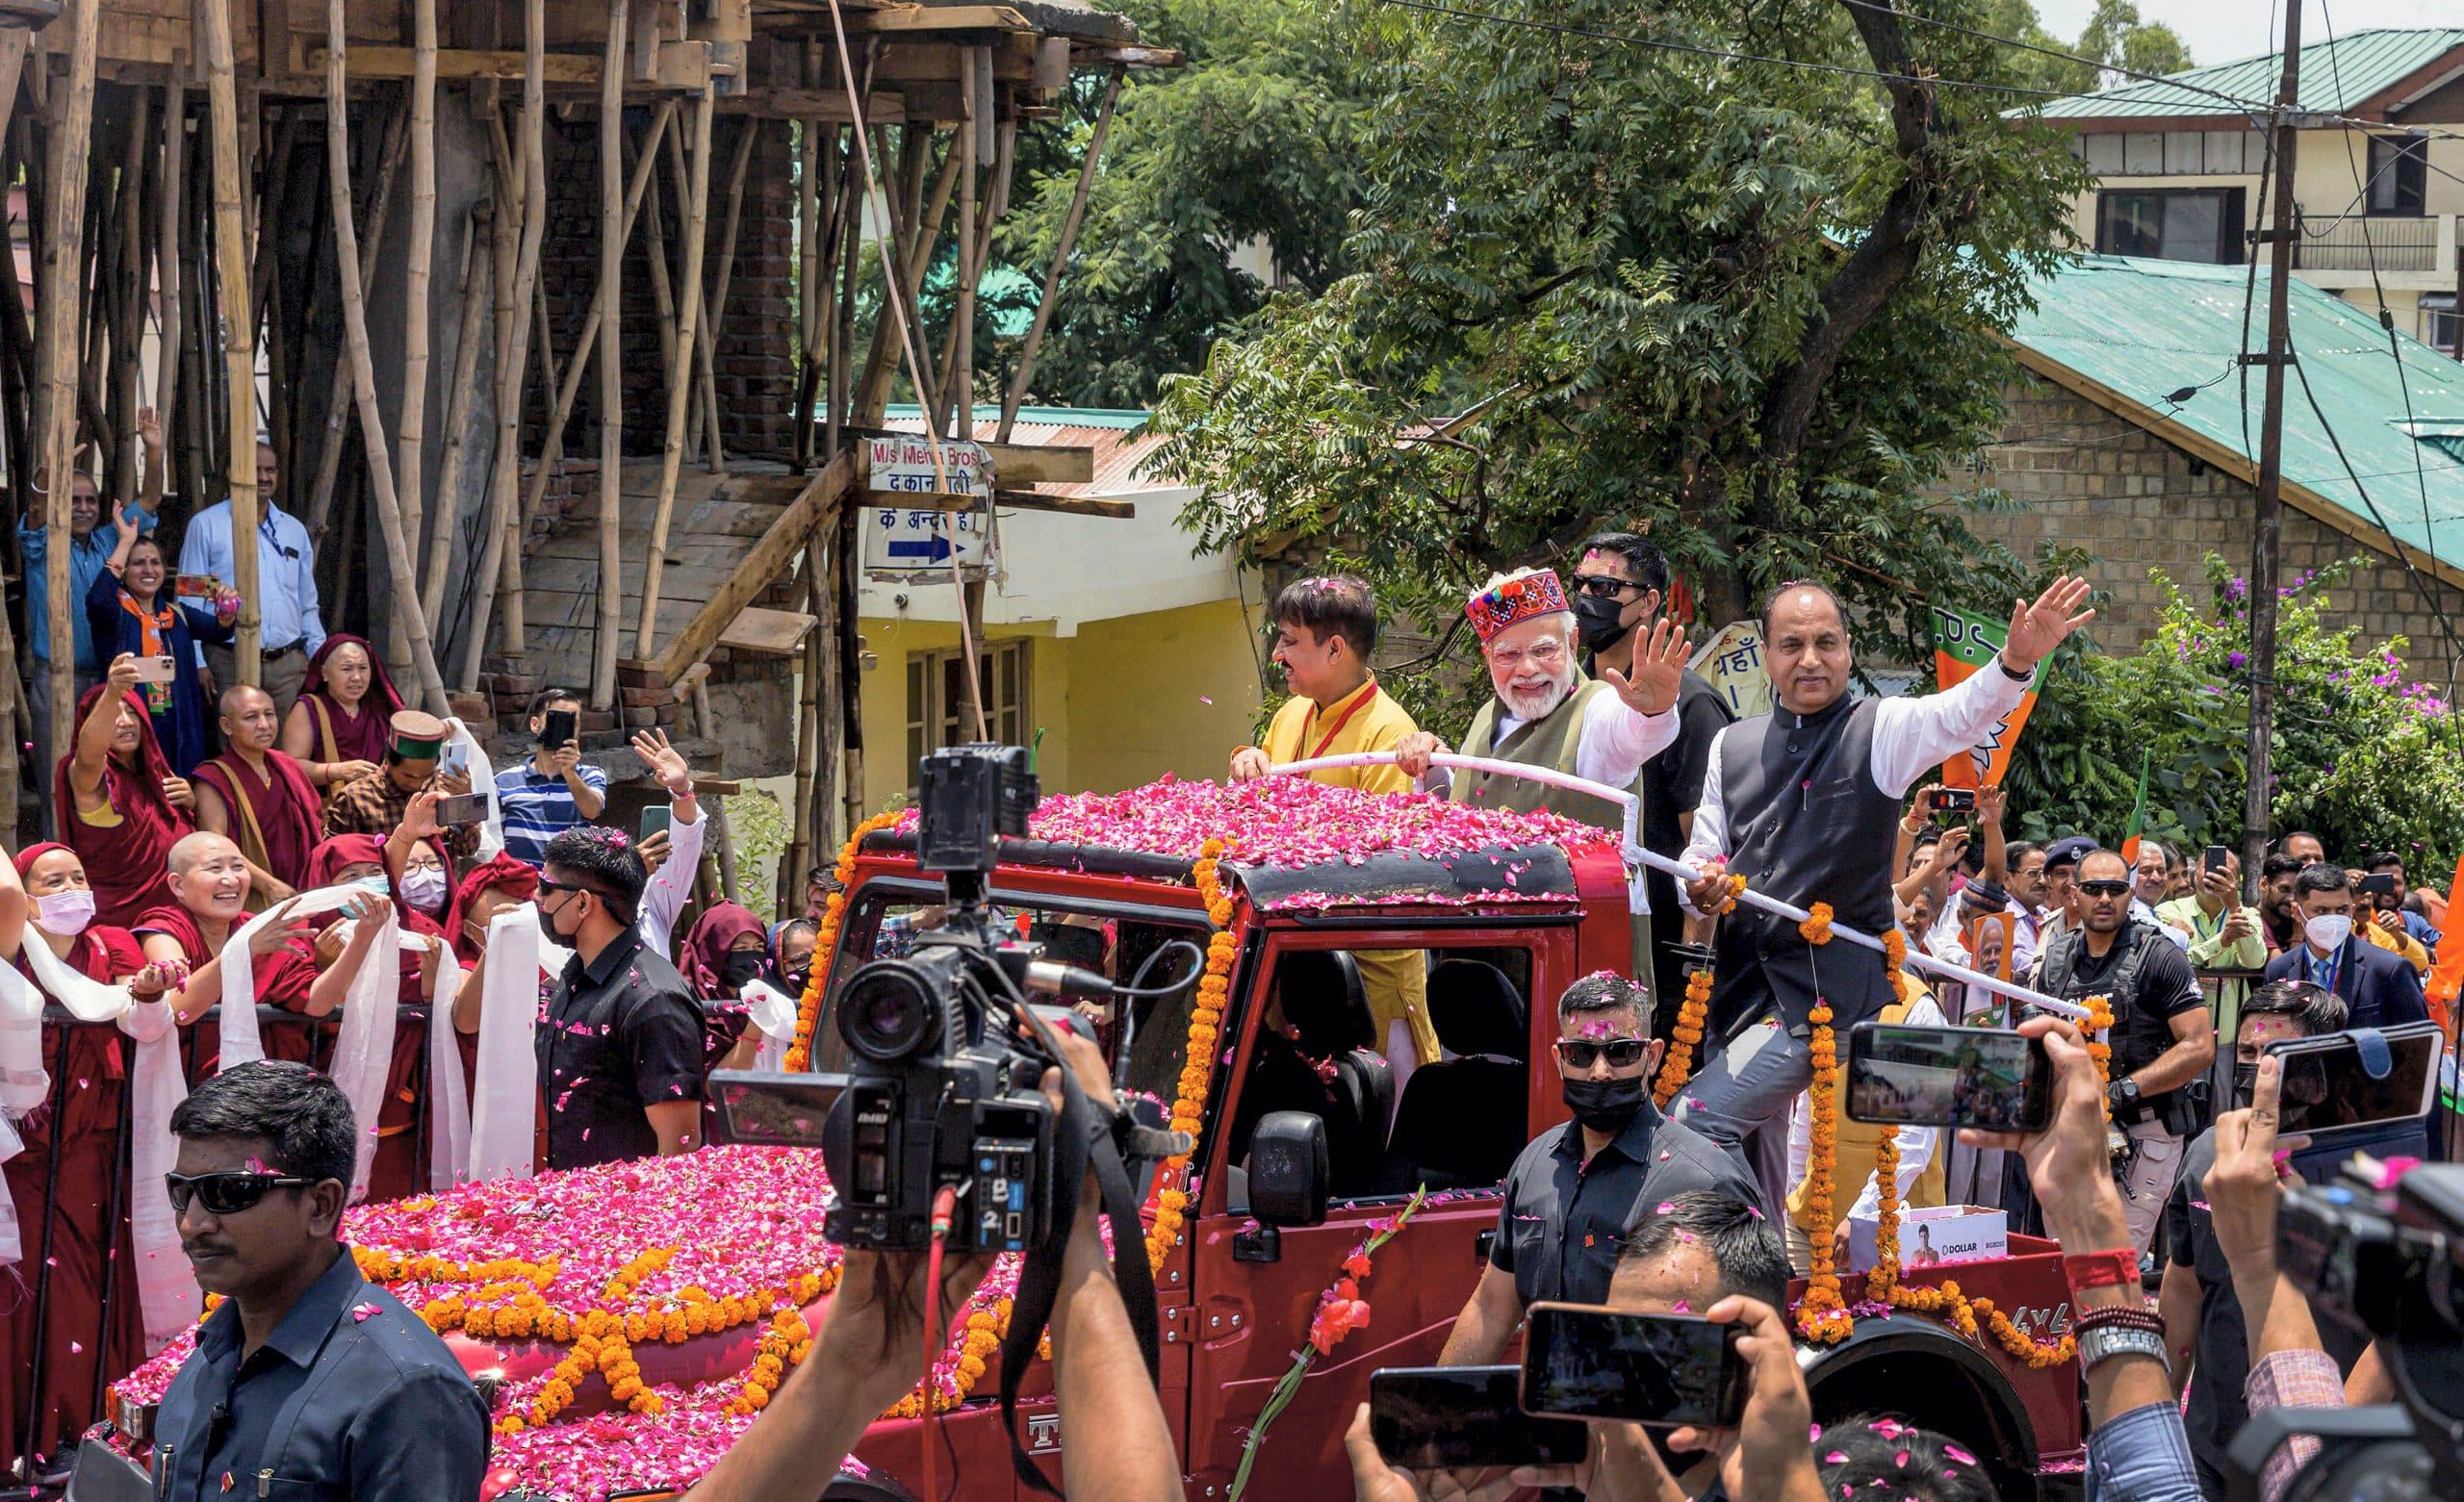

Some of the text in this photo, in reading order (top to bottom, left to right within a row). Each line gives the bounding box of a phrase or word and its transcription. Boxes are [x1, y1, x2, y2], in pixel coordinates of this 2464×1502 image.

[873, 444, 898, 463] M/s
[903, 446, 945, 466] Meha
[1949, 1242, 1978, 1254] DOLLAR
